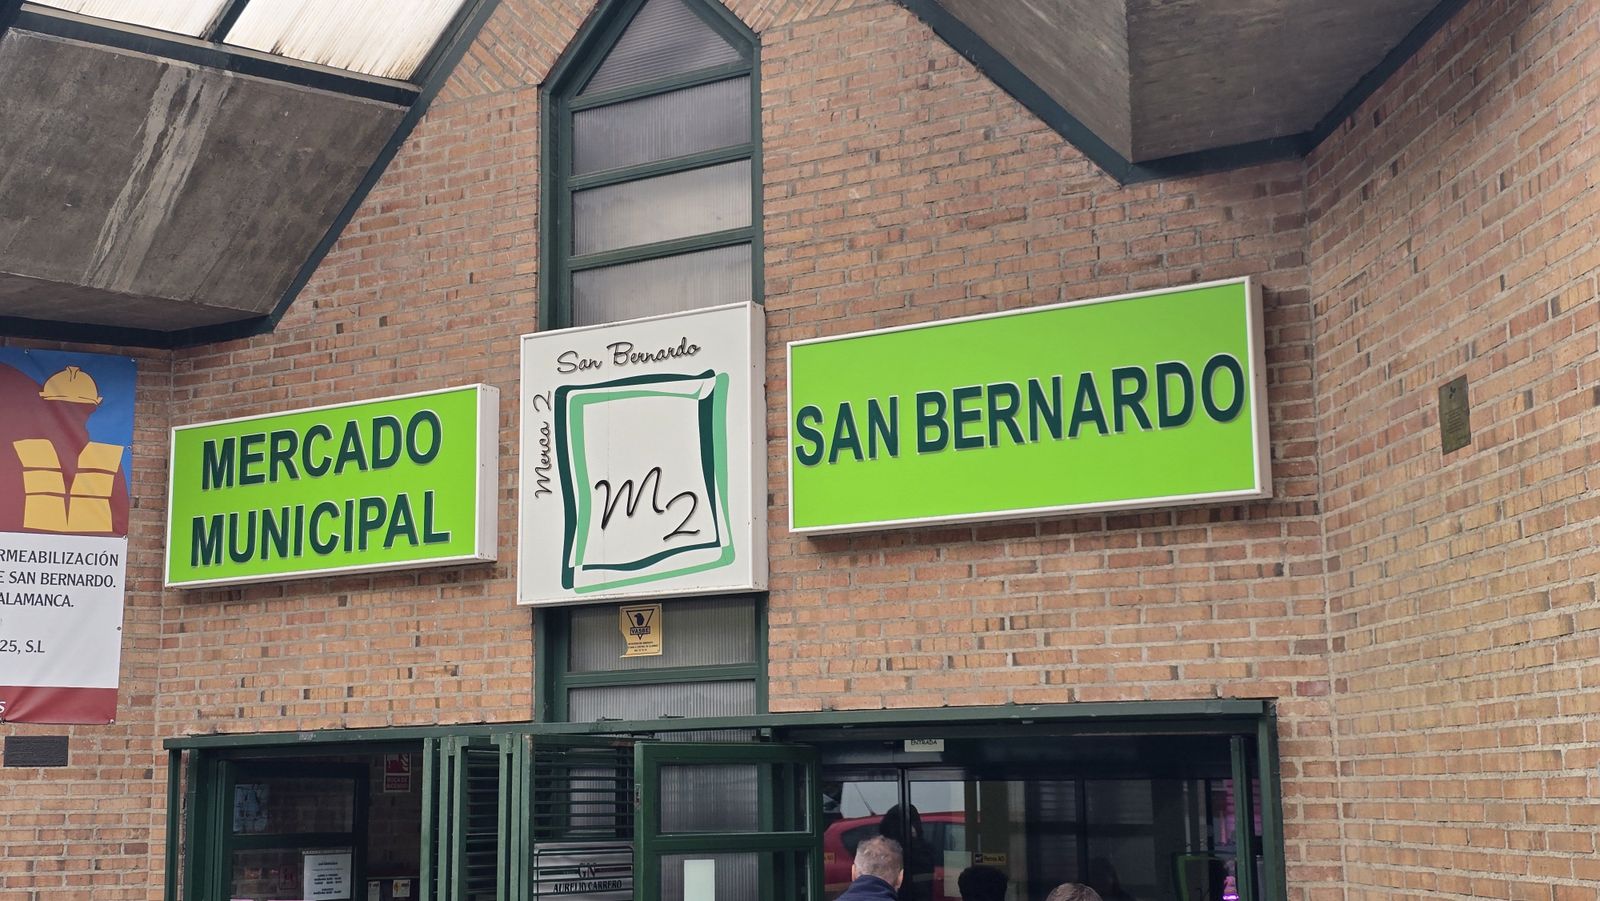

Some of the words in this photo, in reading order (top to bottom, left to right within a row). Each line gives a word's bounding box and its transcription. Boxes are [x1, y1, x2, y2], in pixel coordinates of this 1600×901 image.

[556, 350, 603, 374] San
[606, 336, 701, 366] Bernardo
[532, 390, 553, 413] 2
[795, 396, 900, 467] SAN
[917, 354, 1246, 454] BERNARDO
[202, 410, 442, 491] MERCADO
[534, 421, 553, 499] Merca
[191, 490, 450, 567] MUNICIPAL
[9, 571, 36, 585] SAN
[40, 572, 117, 588] BERNARDO.
[25, 639, 46, 653] S.L
[588, 879, 623, 891] CARRERO
